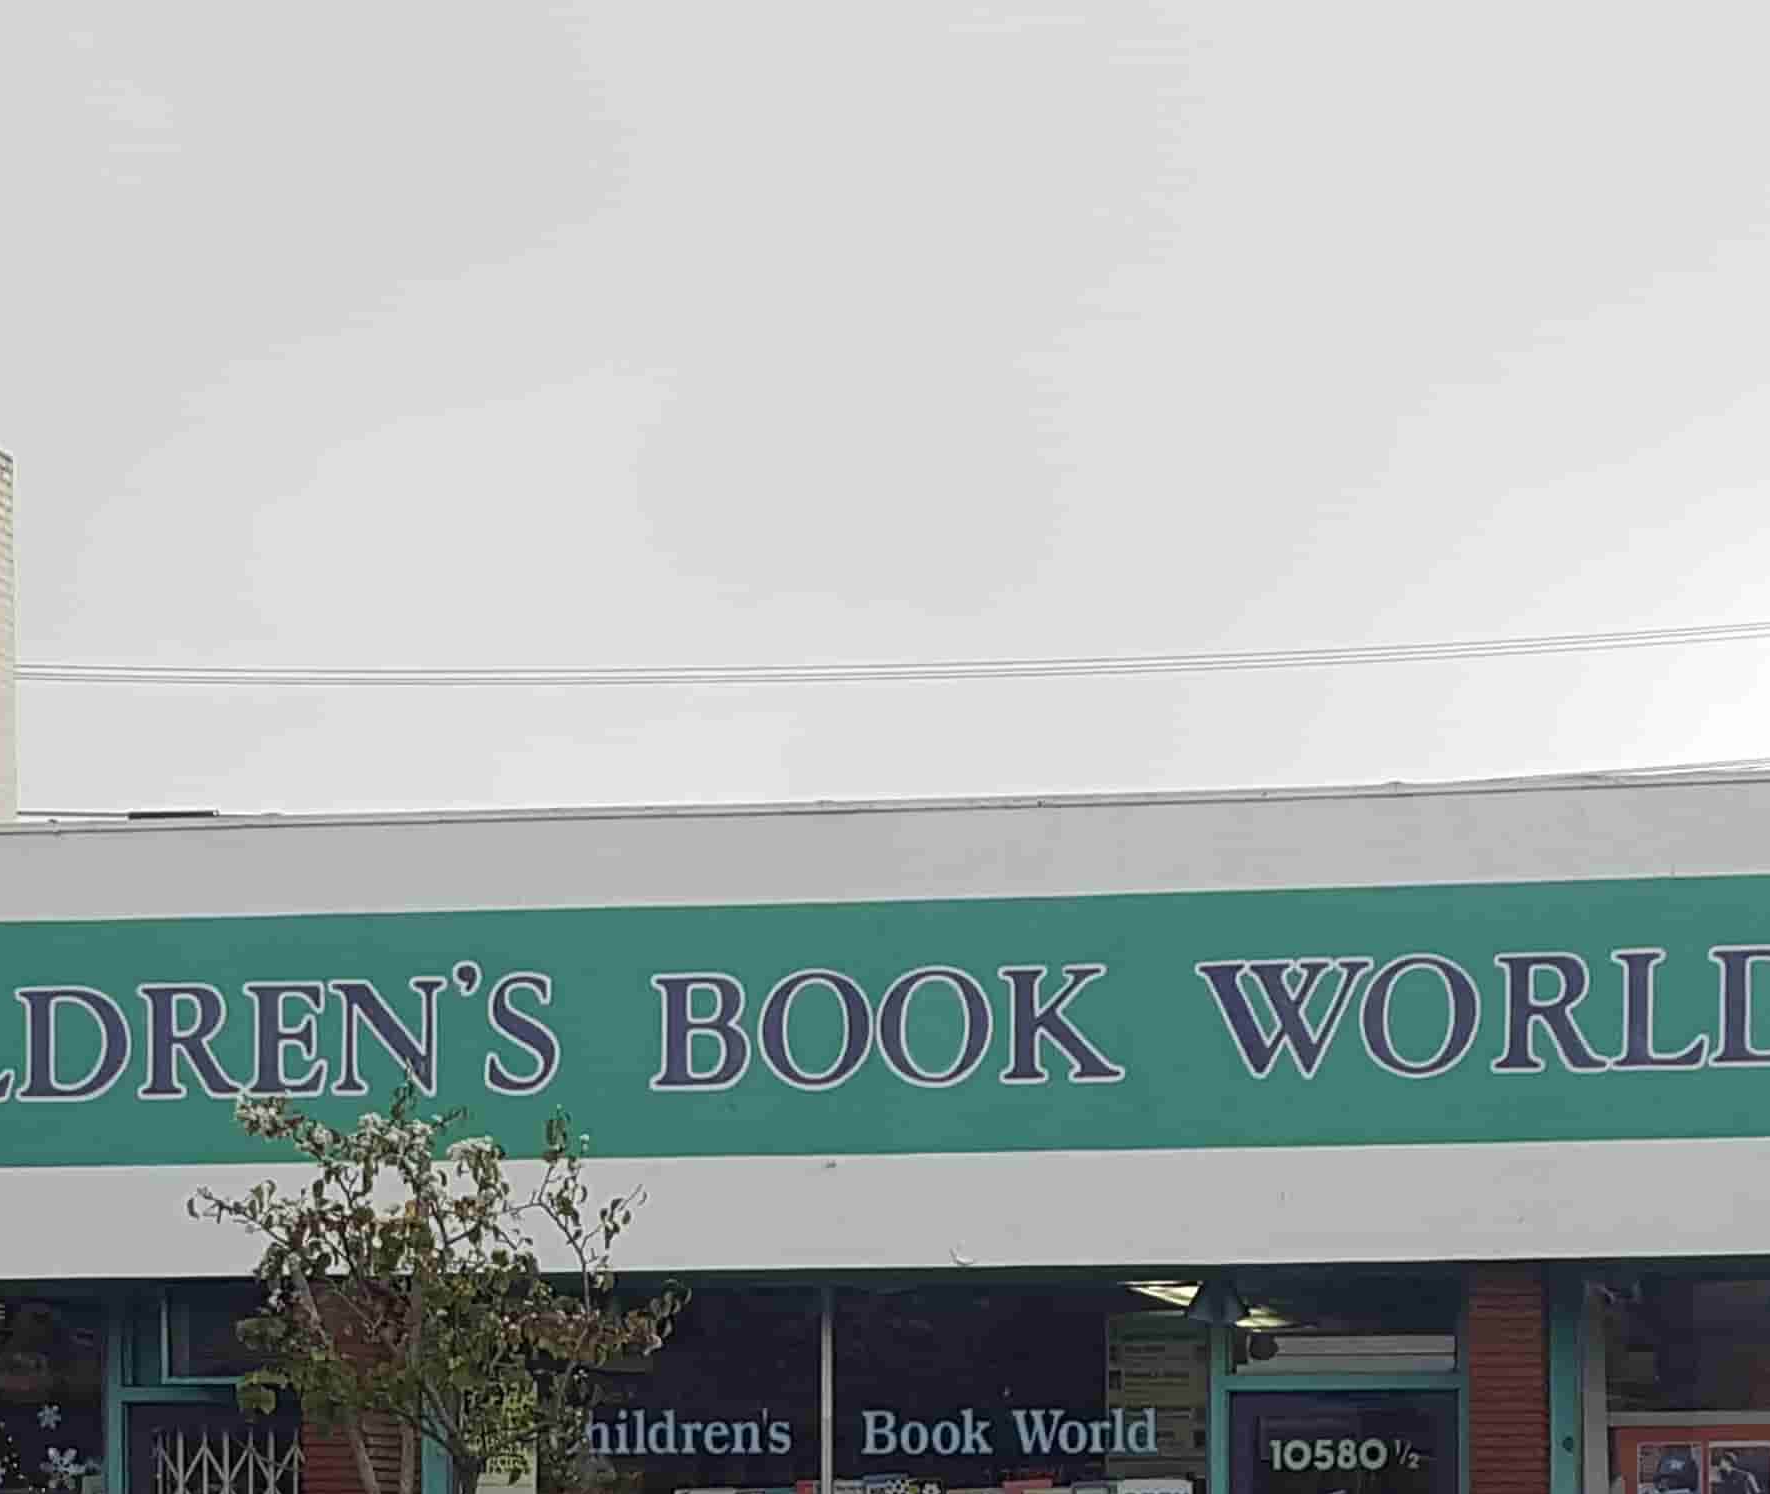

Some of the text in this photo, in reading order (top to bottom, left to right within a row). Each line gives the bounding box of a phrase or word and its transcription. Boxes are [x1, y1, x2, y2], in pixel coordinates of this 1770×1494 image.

[647, 963, 1125, 1093] BOOK
[569, 1408, 1158, 1456] hildren's Book World
[1269, 1438, 1389, 1471] 10580
